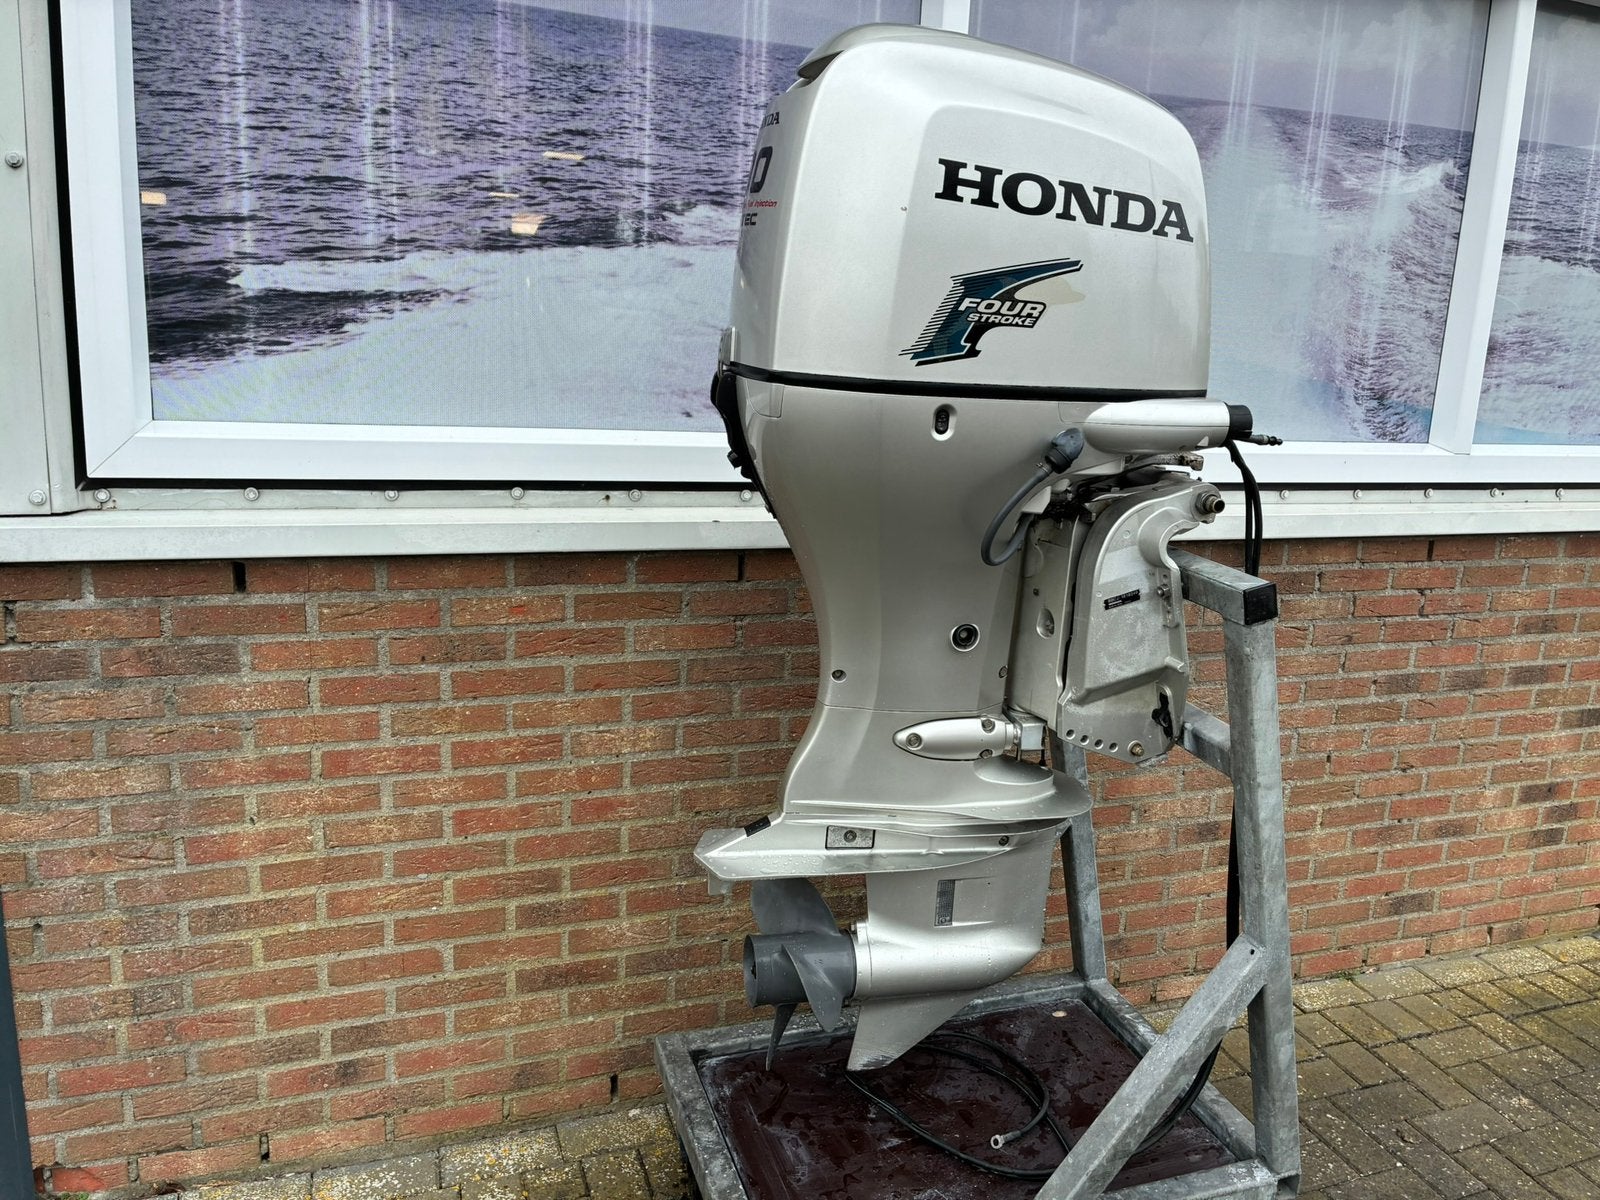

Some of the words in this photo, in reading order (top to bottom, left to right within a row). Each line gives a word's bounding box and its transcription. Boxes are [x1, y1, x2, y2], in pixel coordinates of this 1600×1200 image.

[747, 145, 773, 193] 0
[934, 157, 1194, 243] HONDA
[958, 297, 1045, 318] FOUR
[966, 313, 1037, 326] STROKE
